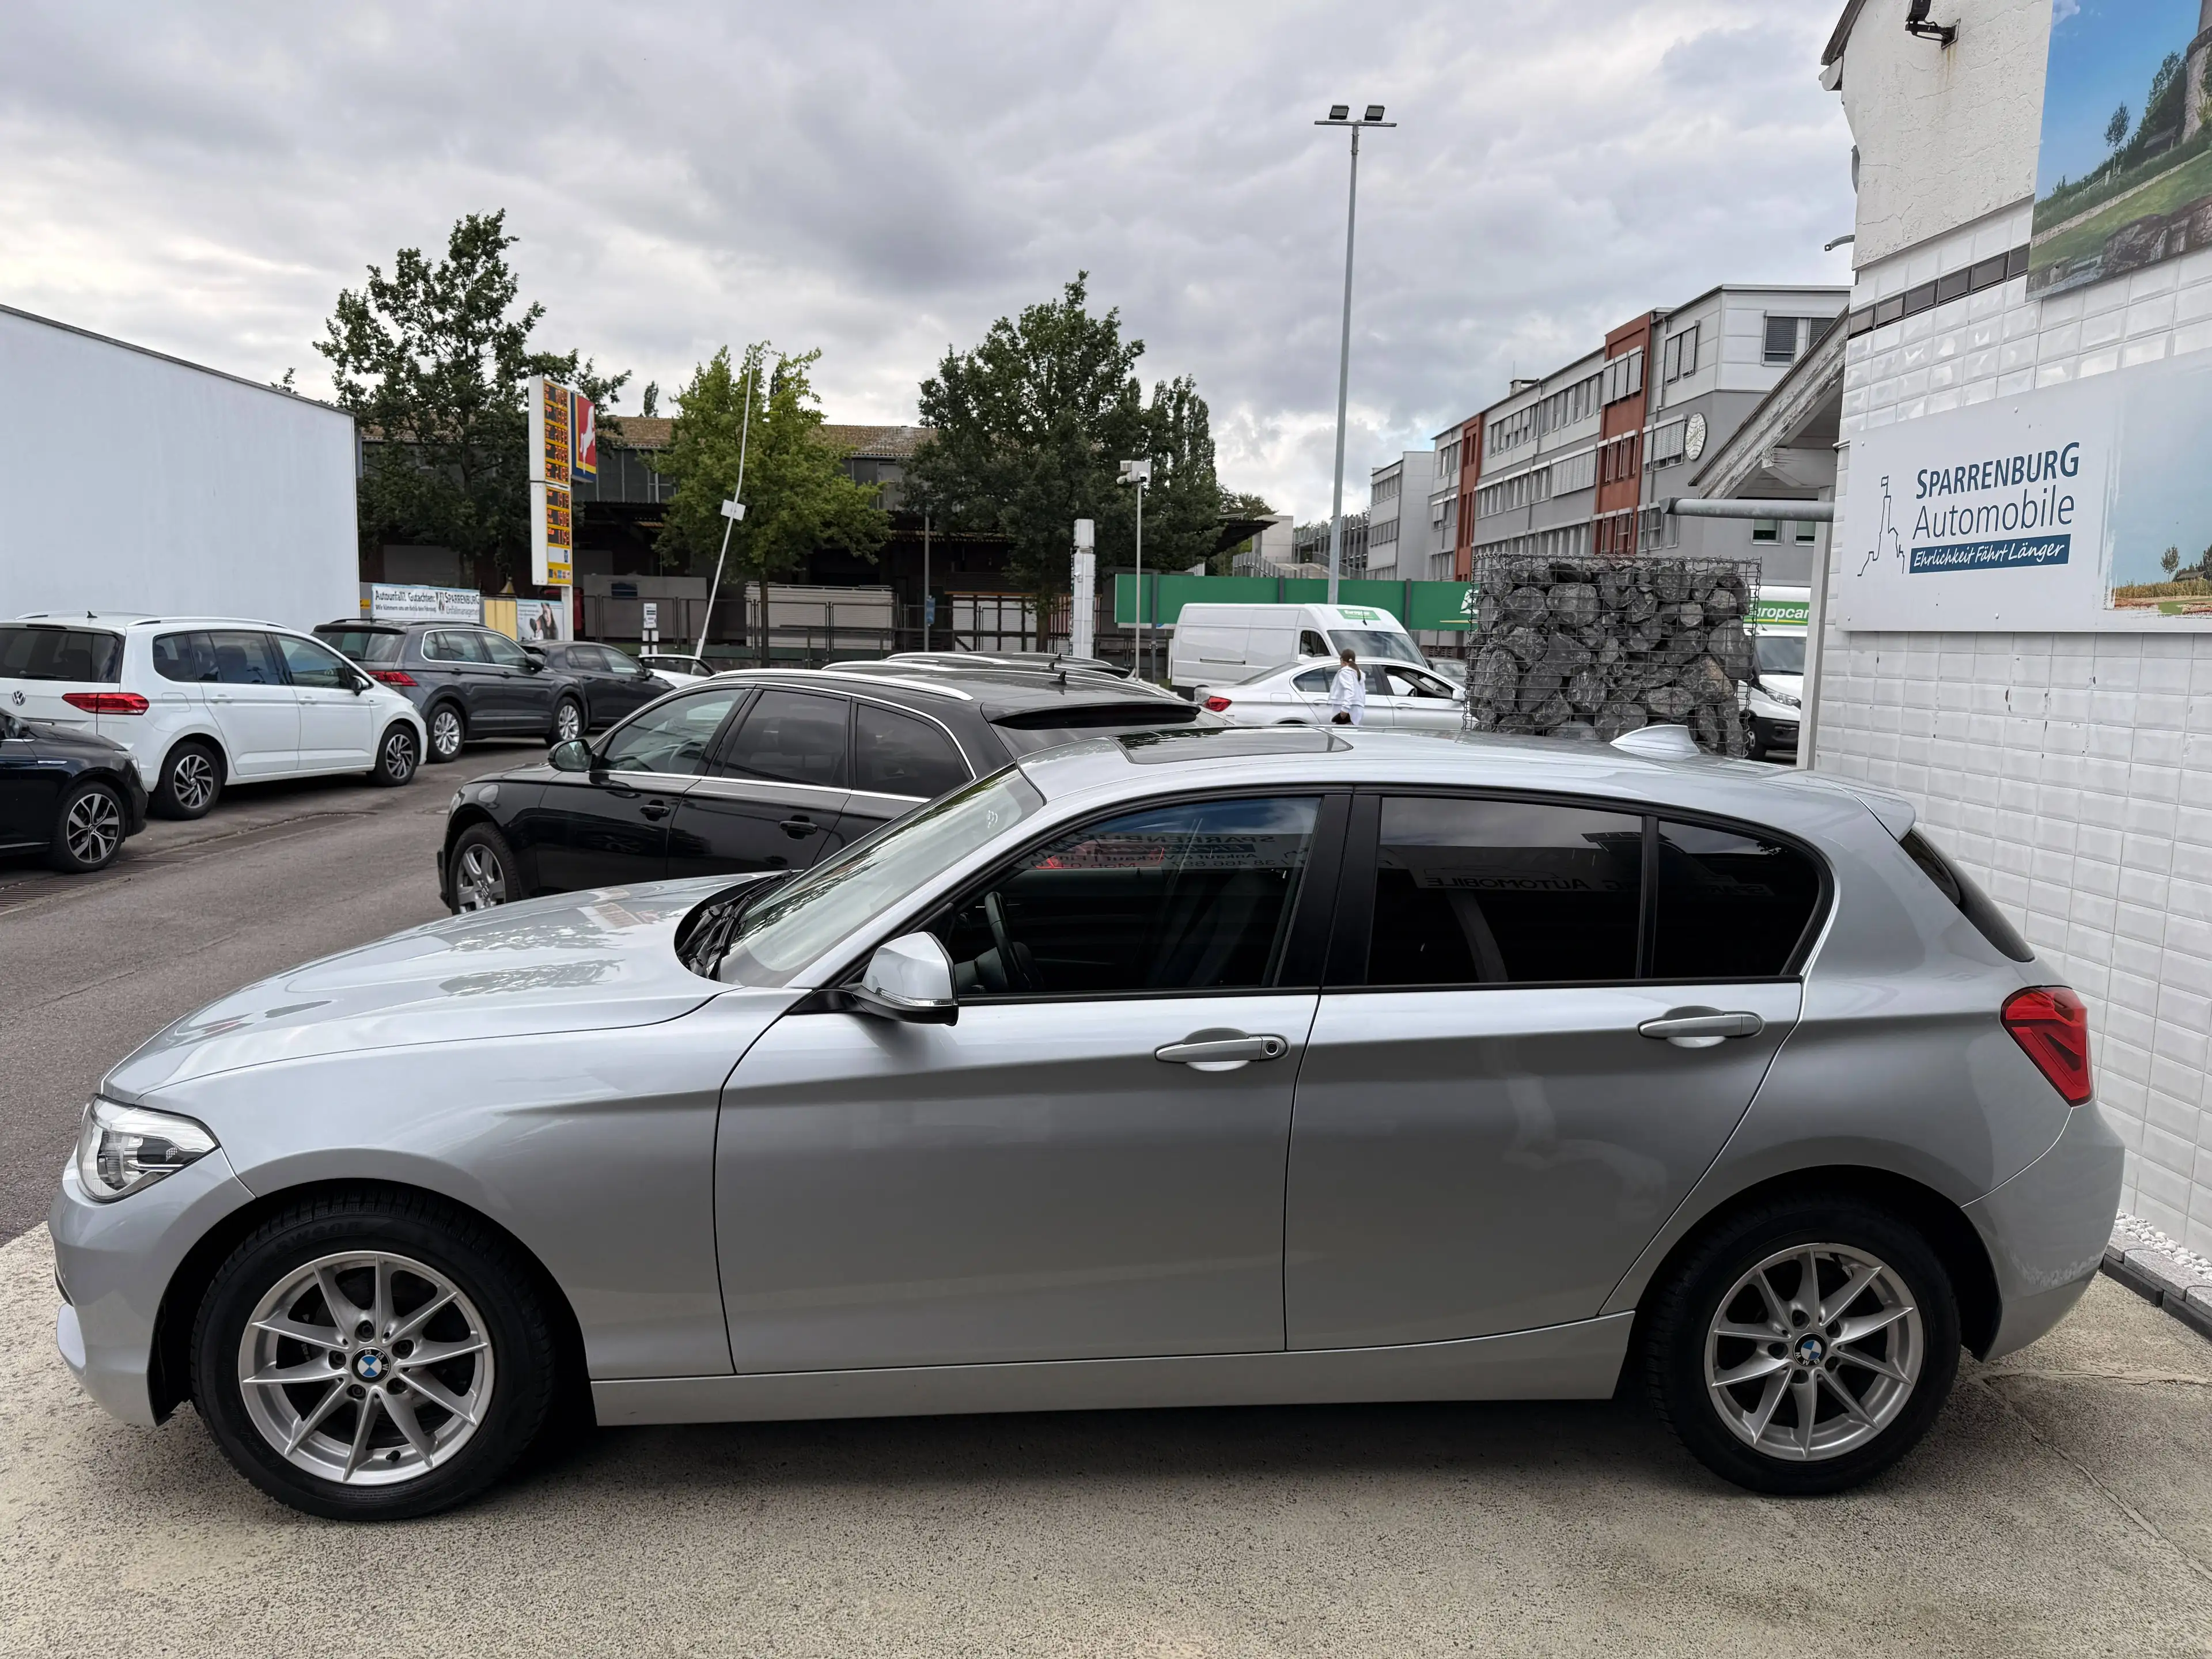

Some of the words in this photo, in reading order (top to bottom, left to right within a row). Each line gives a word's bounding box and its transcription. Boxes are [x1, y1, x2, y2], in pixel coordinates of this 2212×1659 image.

[1916, 442, 2080, 499] SPARRENBURG
[1912, 484, 2075, 540] Automobile
[1913, 546, 1975, 567] Ehrlichkeit
[1975, 544, 2009, 563] Fährt
[2008, 542, 2065, 563] Länger
[365, 1349, 389, 1371] BMW
[1795, 1351, 1820, 1366] BMW
